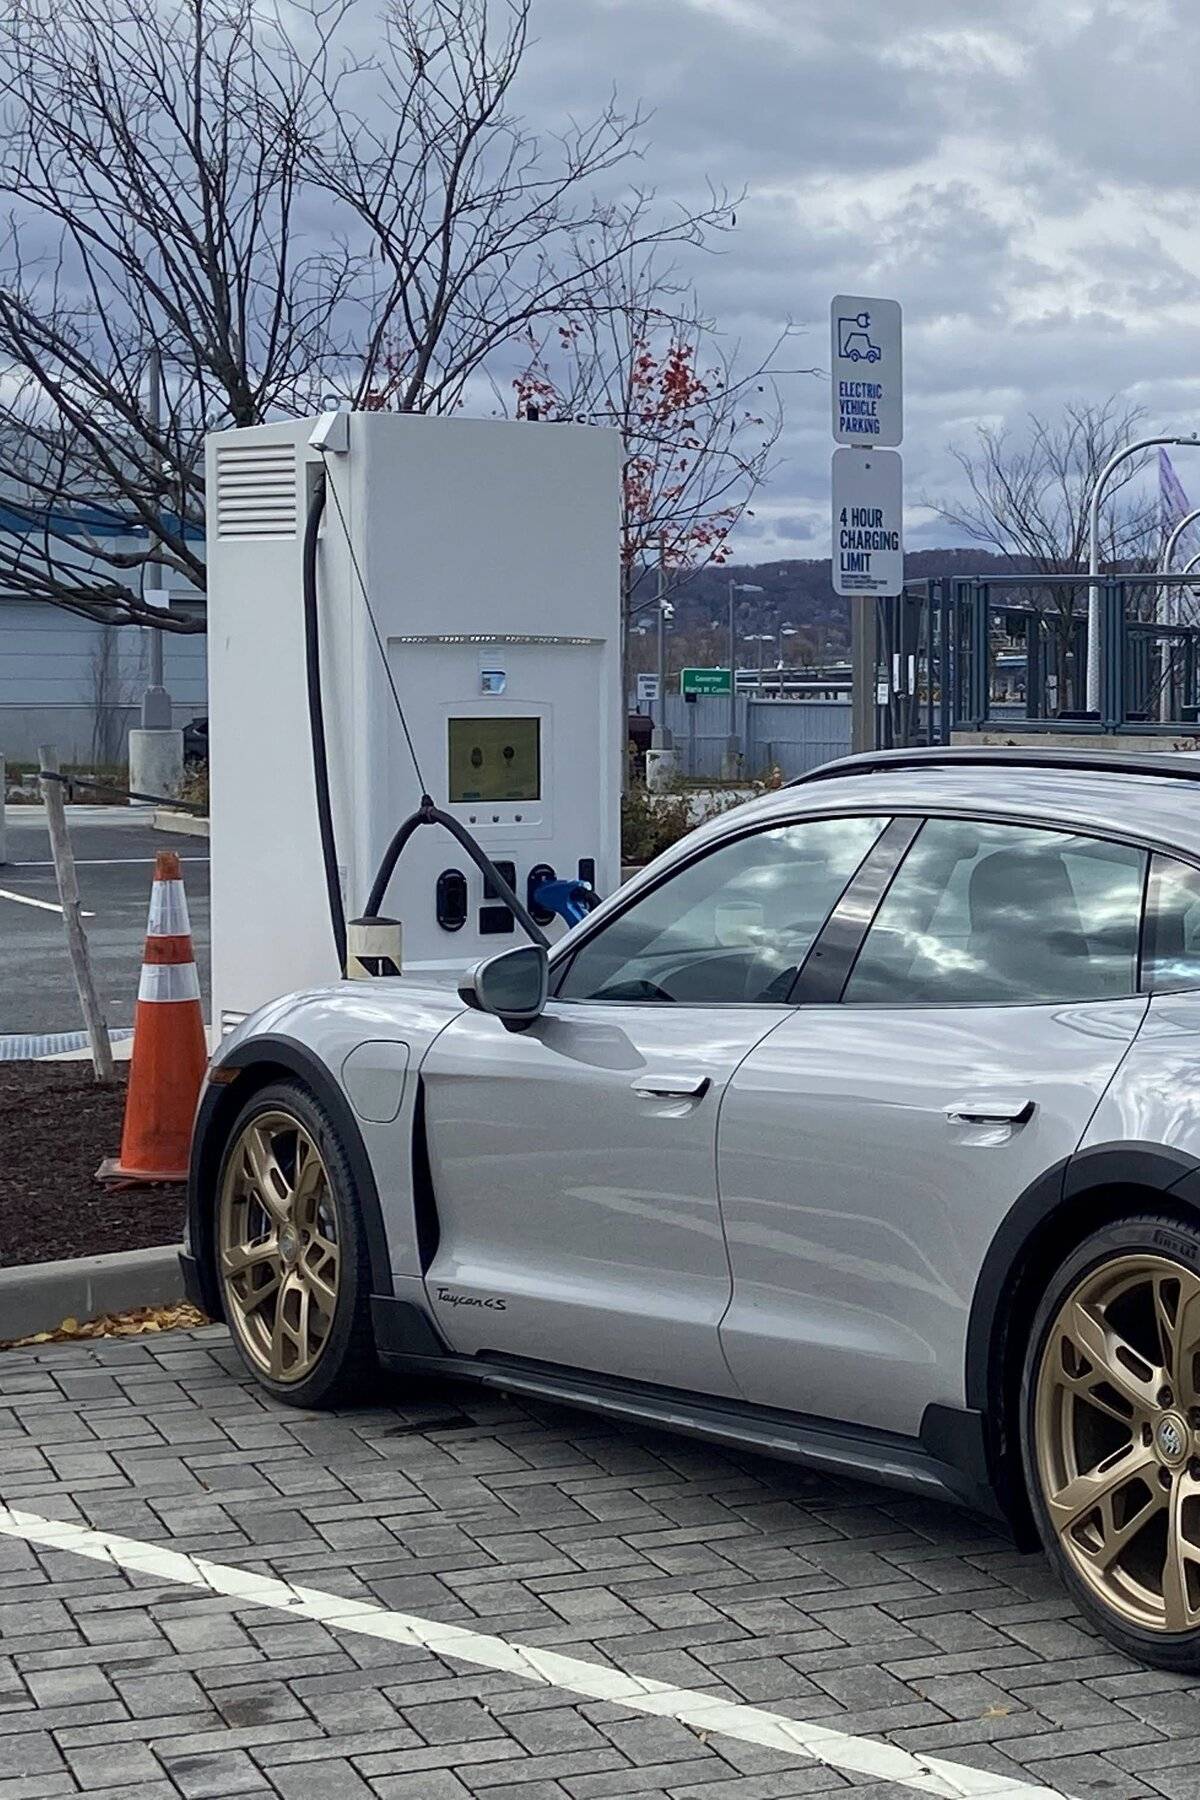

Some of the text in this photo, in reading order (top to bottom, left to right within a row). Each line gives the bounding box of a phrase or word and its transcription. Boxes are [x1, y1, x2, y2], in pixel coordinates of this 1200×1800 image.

[839, 382, 882, 399] ELECTRIC
[839, 399, 877, 416] VEHICLE
[840, 417, 880, 434] PARKING
[840, 507, 883, 528] 4 HOUR
[840, 530, 899, 551] CHARGING
[840, 552, 872, 572] LIMIT
